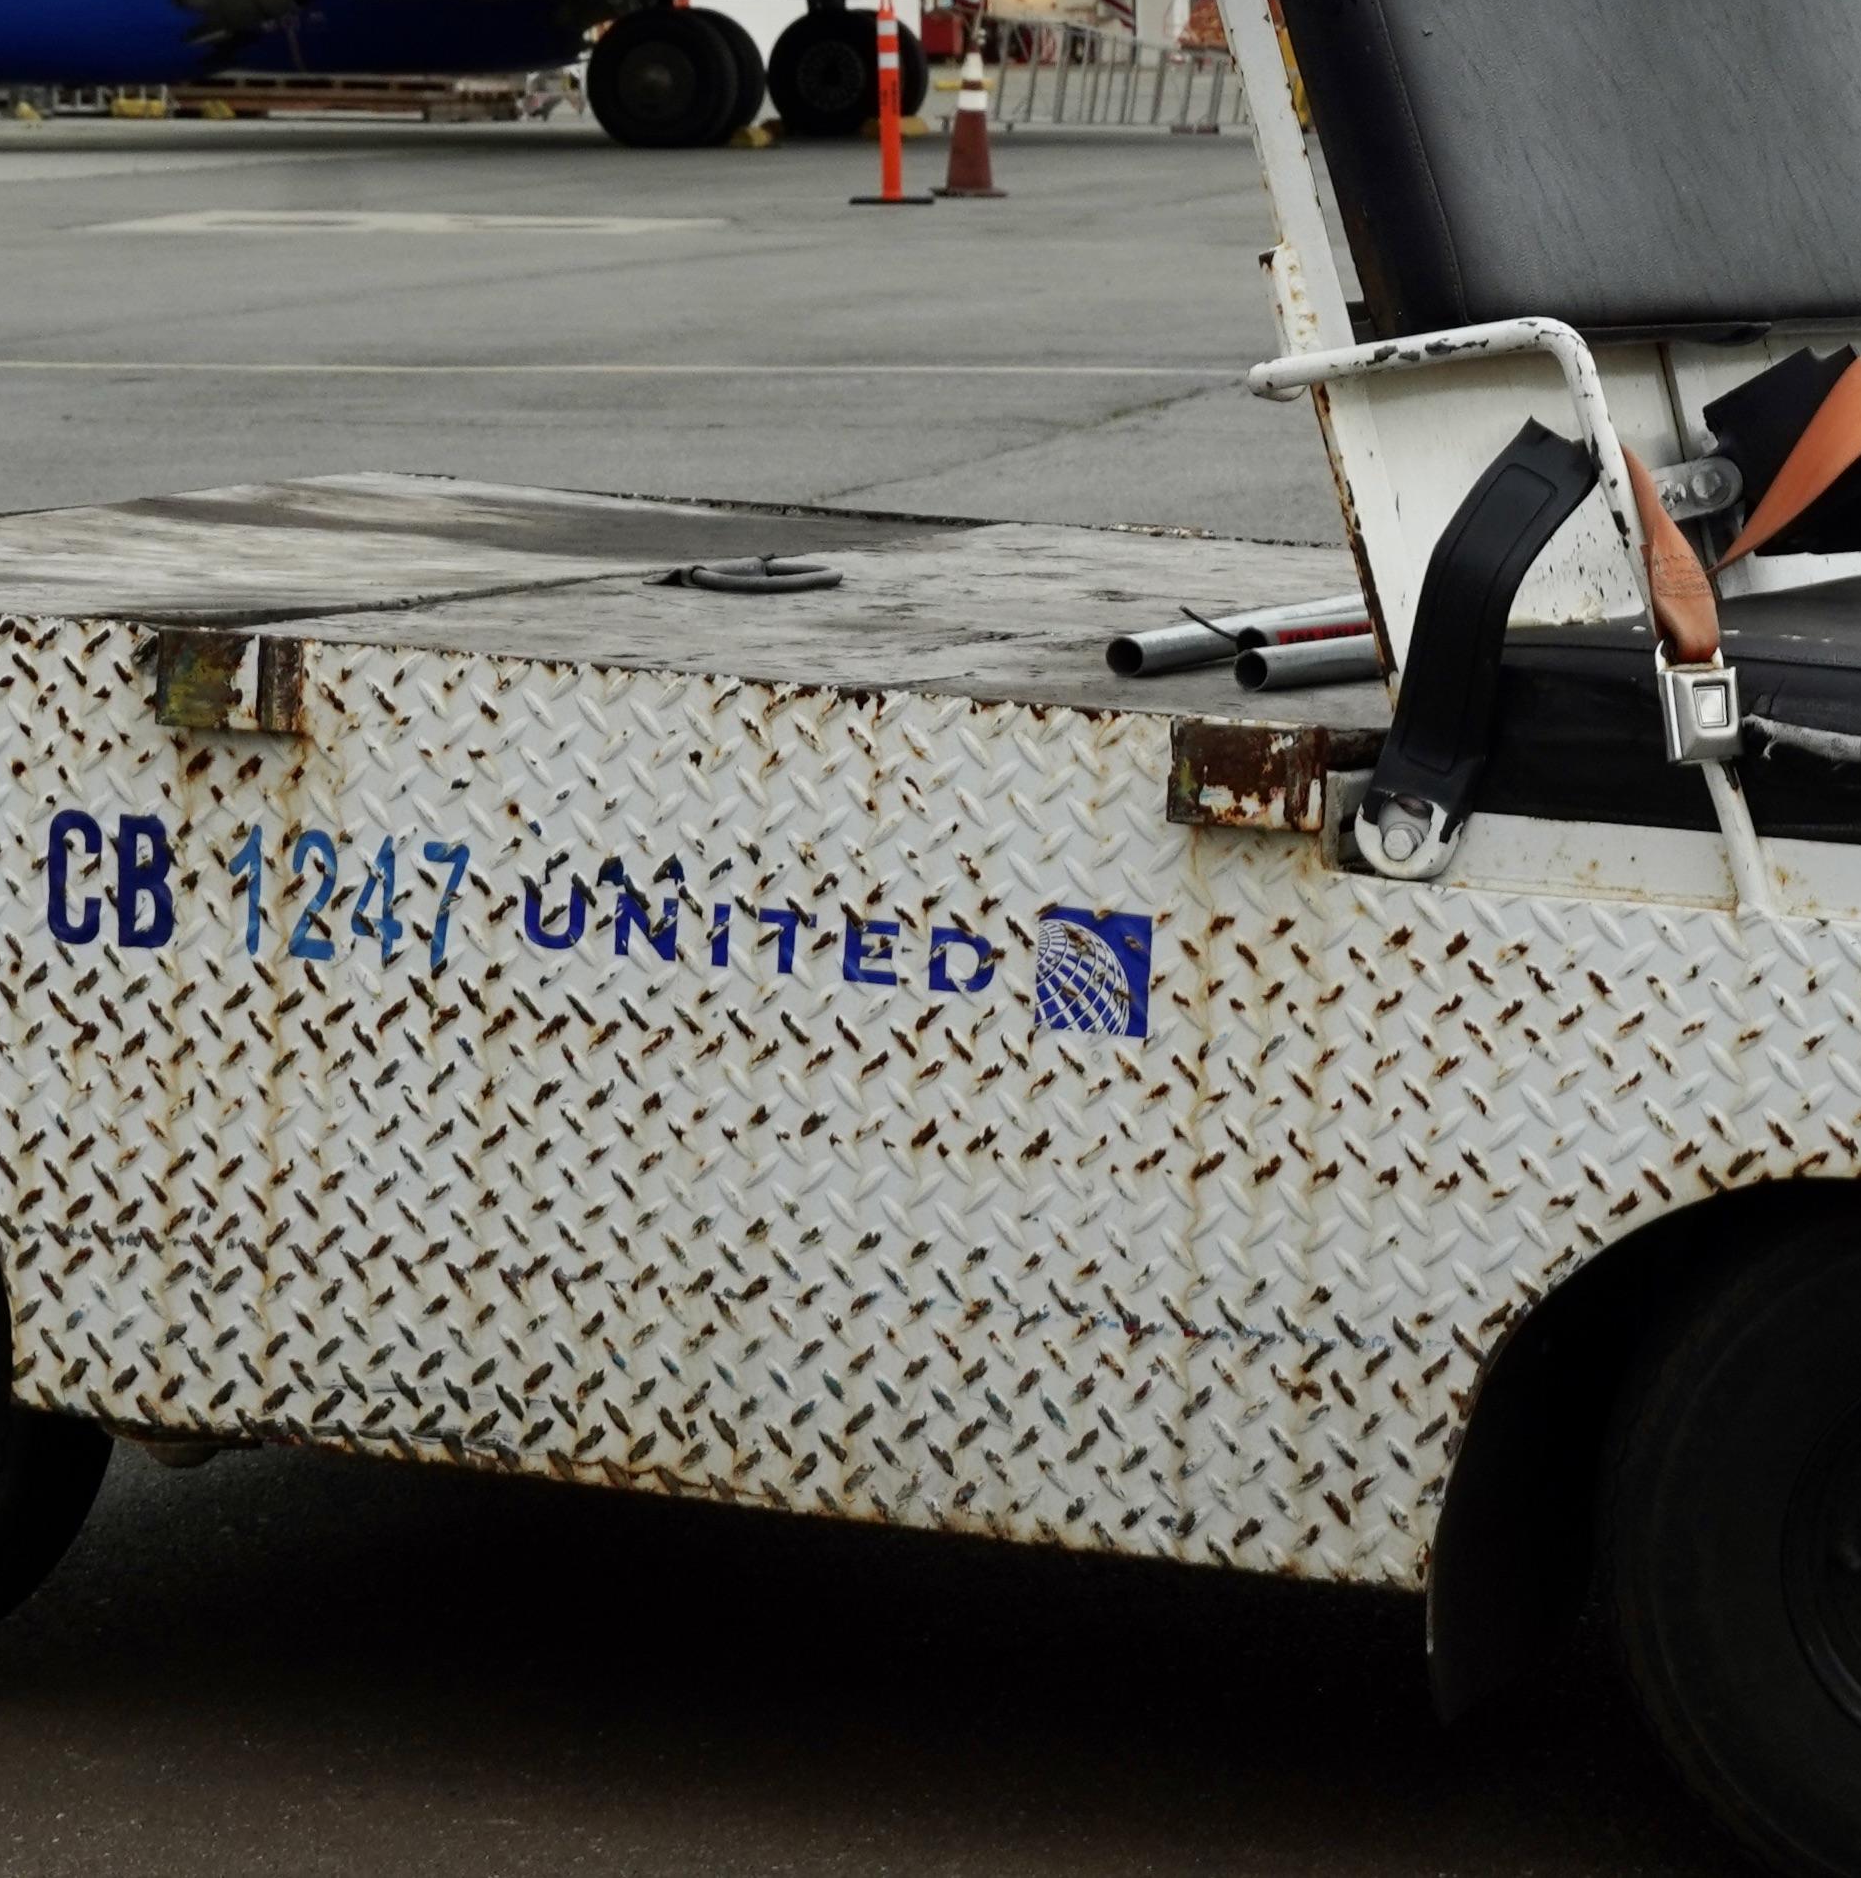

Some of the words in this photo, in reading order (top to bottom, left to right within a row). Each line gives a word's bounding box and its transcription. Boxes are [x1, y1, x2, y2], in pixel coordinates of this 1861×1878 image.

[47, 808, 175, 949] CB
[228, 823, 471, 970] 1247
[522, 880, 997, 994] UNITED
